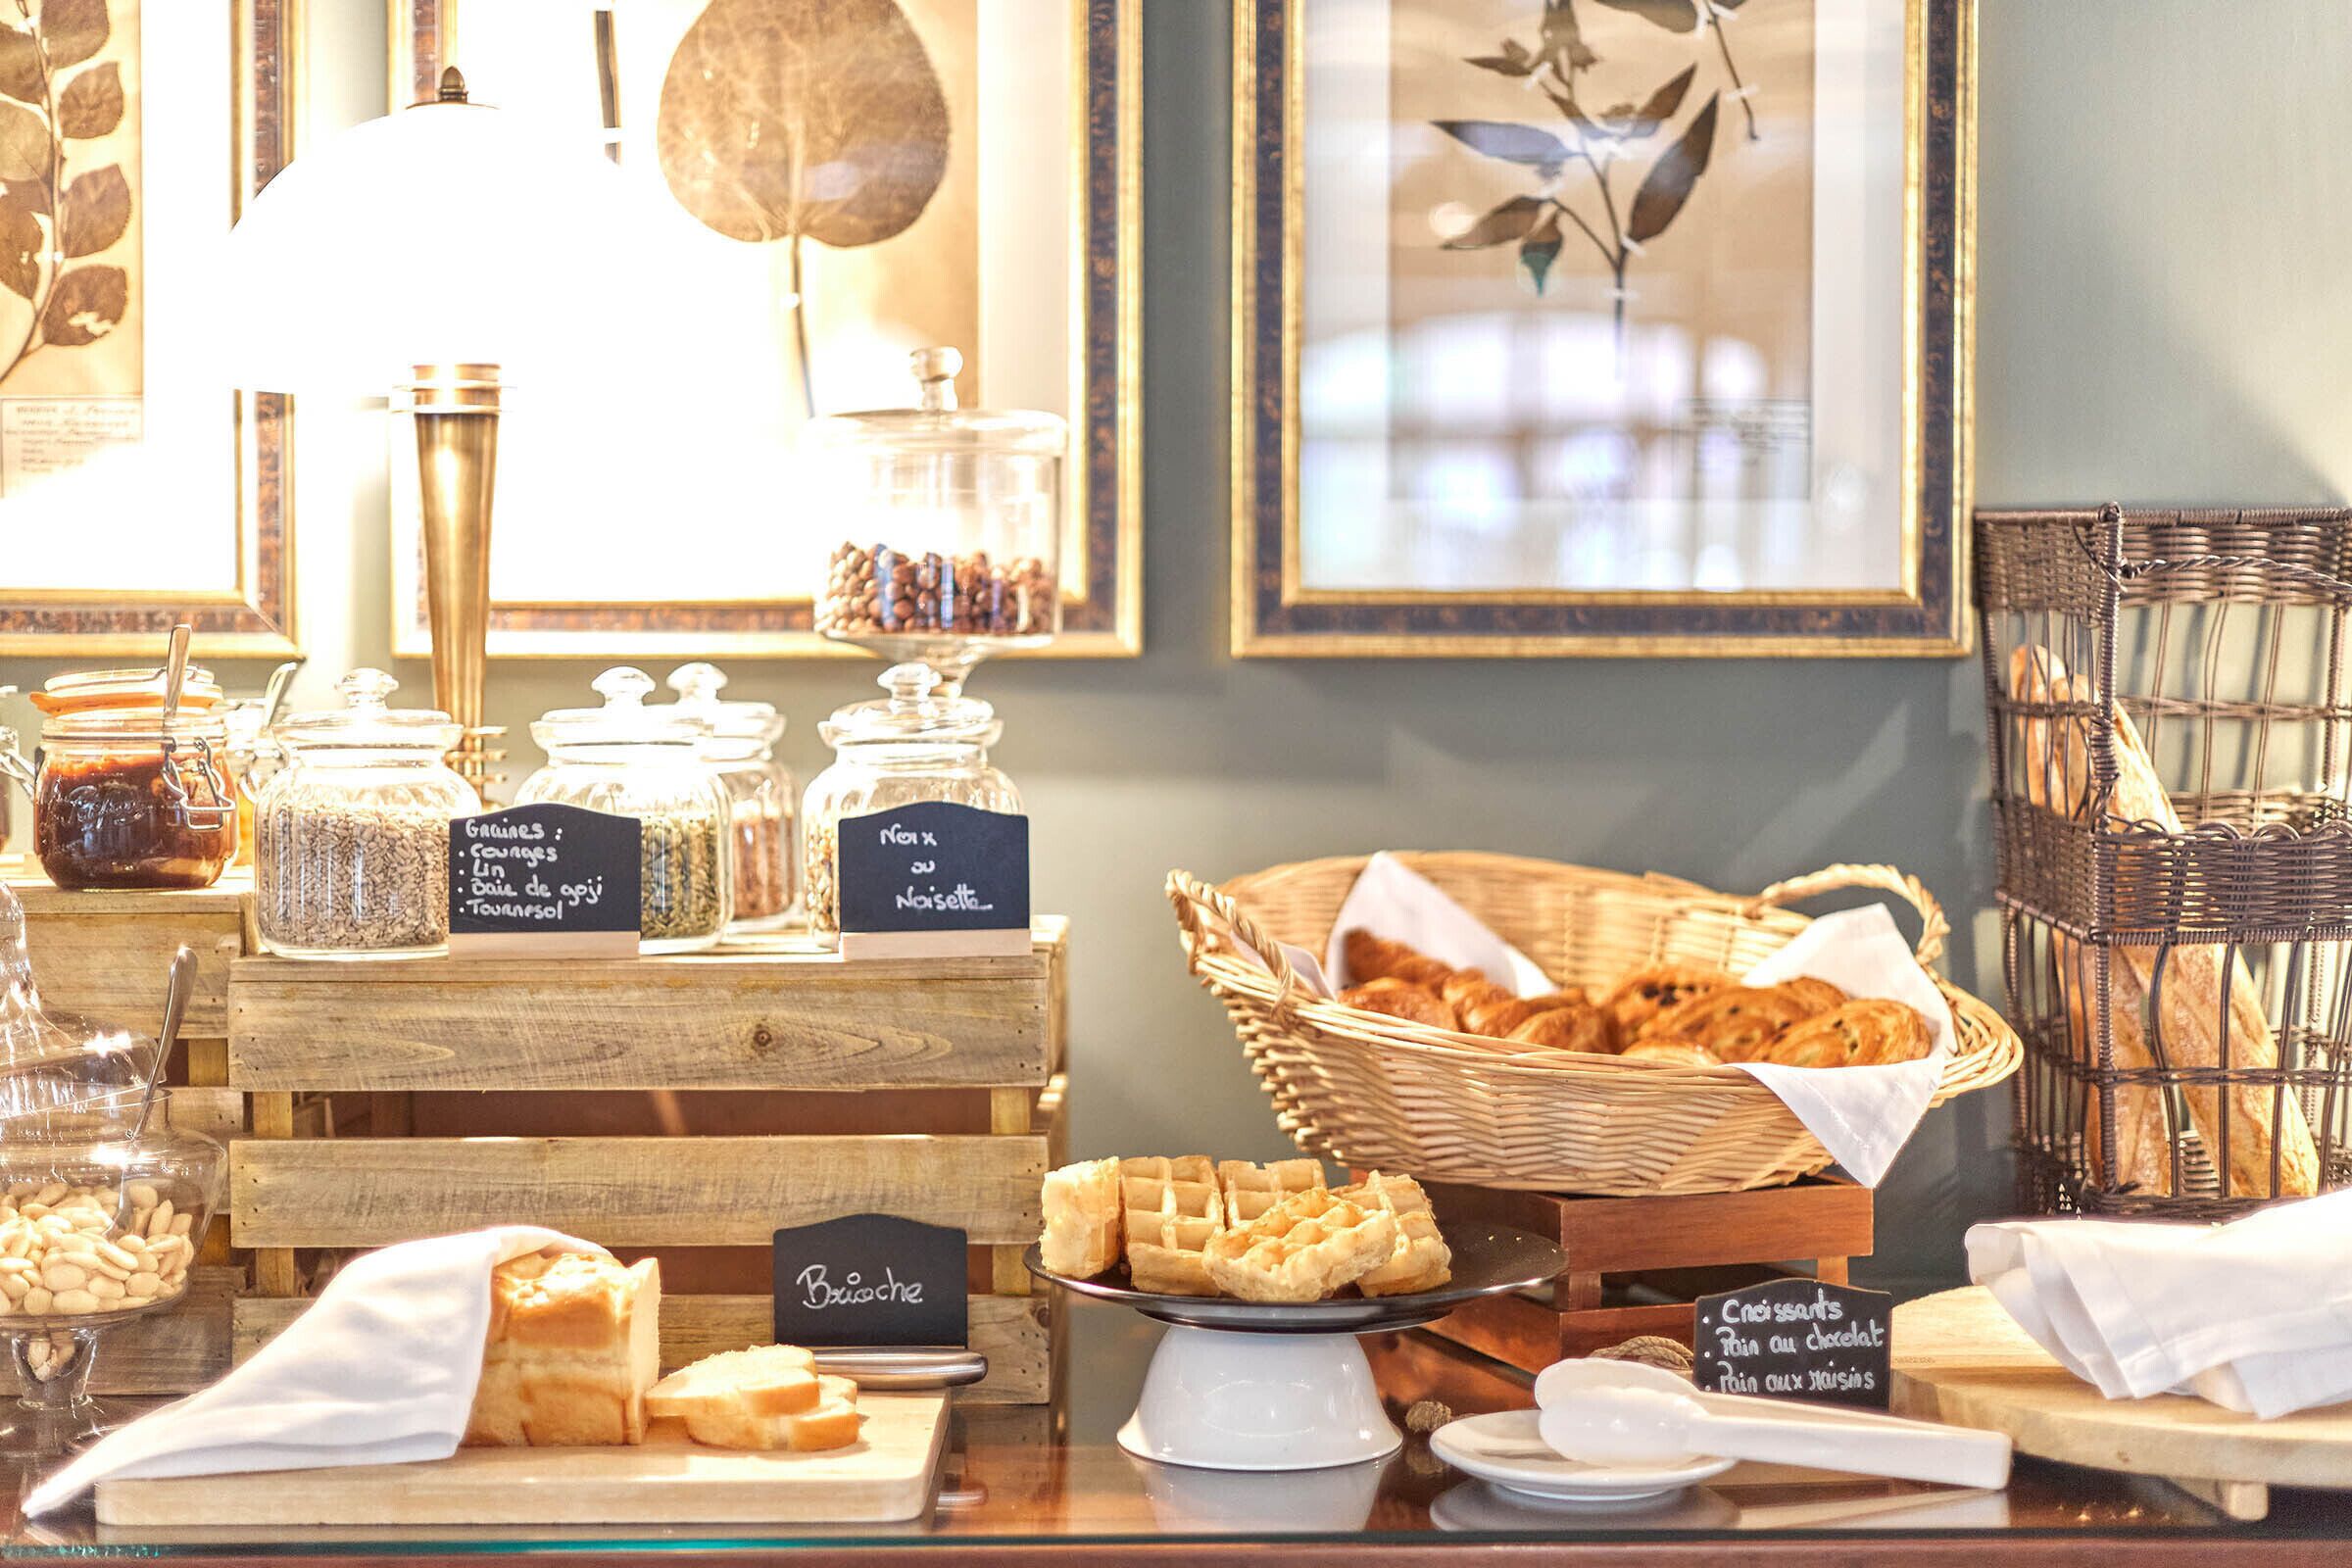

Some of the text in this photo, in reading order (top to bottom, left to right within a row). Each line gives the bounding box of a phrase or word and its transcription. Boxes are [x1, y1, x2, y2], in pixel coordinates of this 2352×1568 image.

[466, 817, 545, 840] Graines
[469, 843, 558, 867] Courges
[472, 858, 505, 878] Lin
[910, 859, 936, 874] ou
[470, 874, 603, 906] Baie de goji
[466, 898, 563, 919] Tournesol
[796, 1264, 923, 1309] Brioche
[1722, 1287, 1843, 1324] Croissants
[1715, 1318, 1885, 1356] Pain au chocolat
[1716, 1360, 1758, 1394] Pain
[1765, 1373, 1802, 1393] aux
